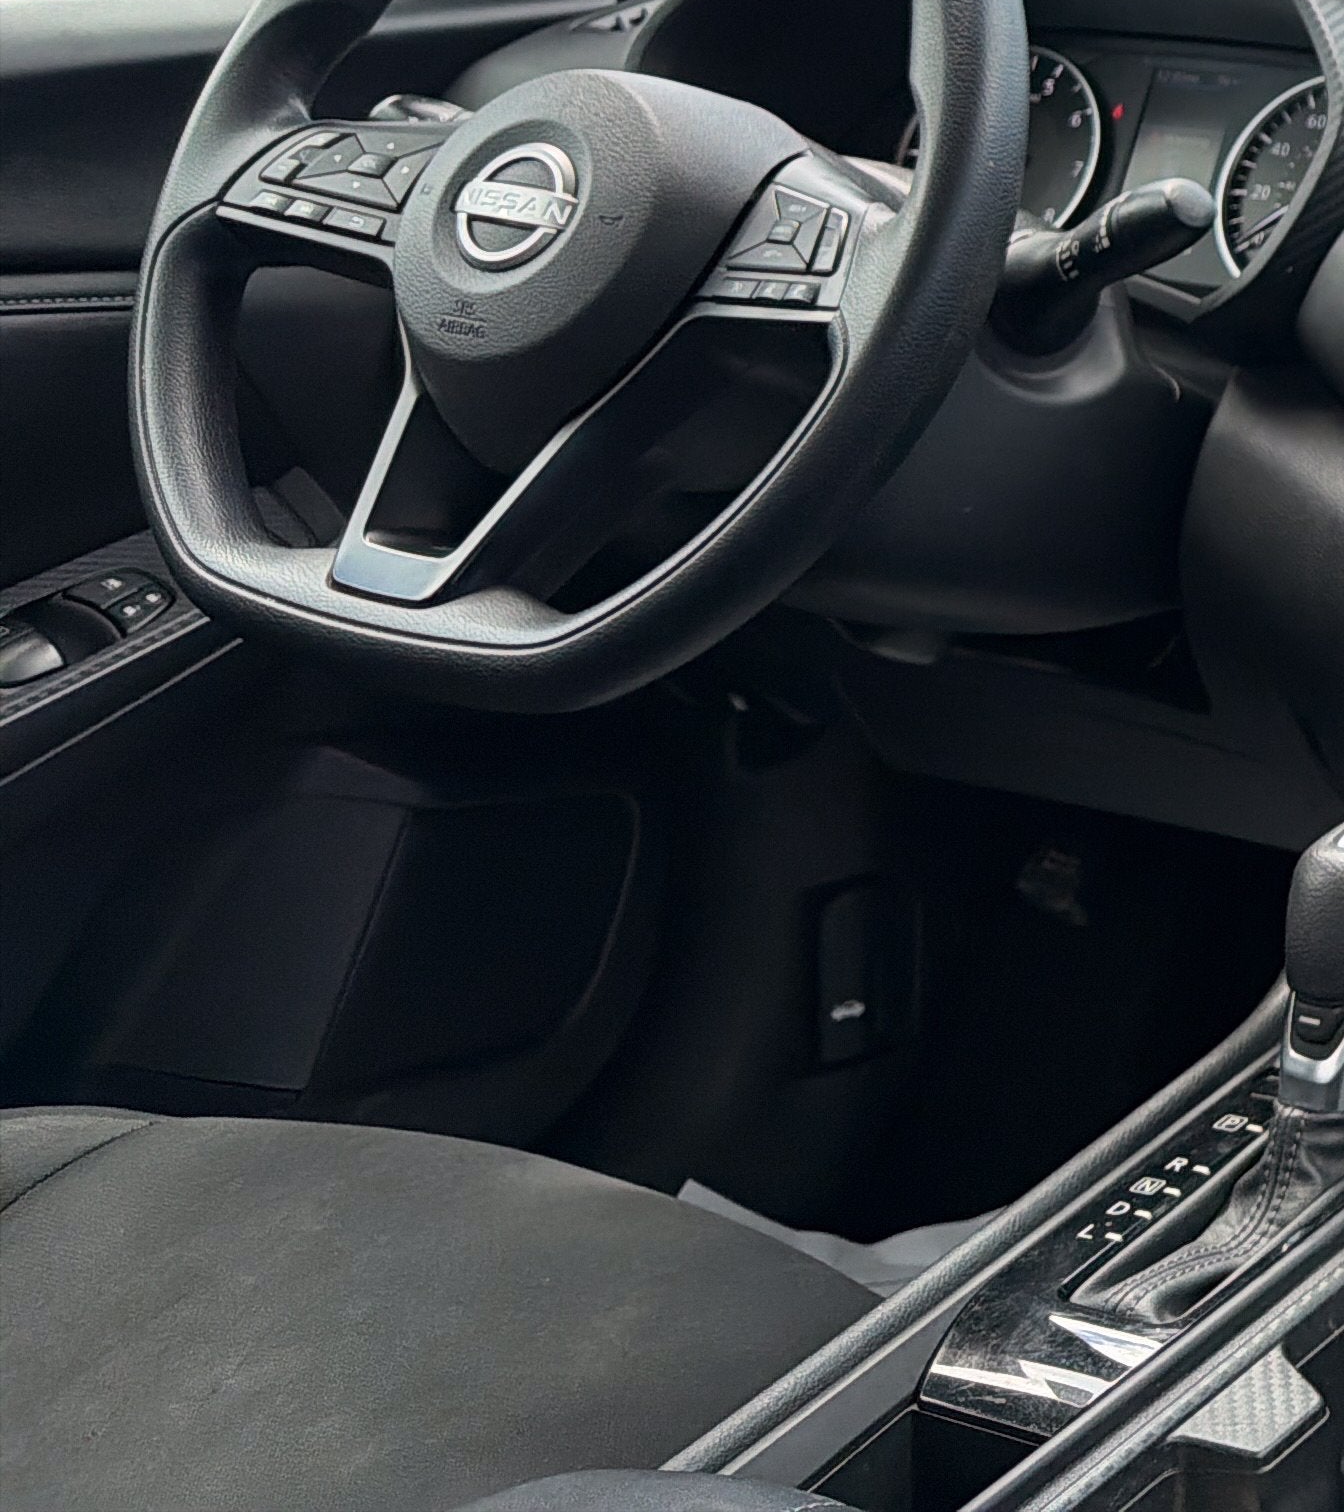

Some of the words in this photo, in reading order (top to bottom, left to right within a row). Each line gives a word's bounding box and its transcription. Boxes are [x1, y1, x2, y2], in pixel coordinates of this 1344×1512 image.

[1307, 114, 1327, 129] 60
[1272, 142, 1290, 157] 40
[1252, 185, 1271, 201] 20
[462, 188, 573, 225] NISSAN
[1166, 1156, 1188, 1172] R
[1106, 1201, 1130, 1217] D
[1077, 1224, 1093, 1239] L
